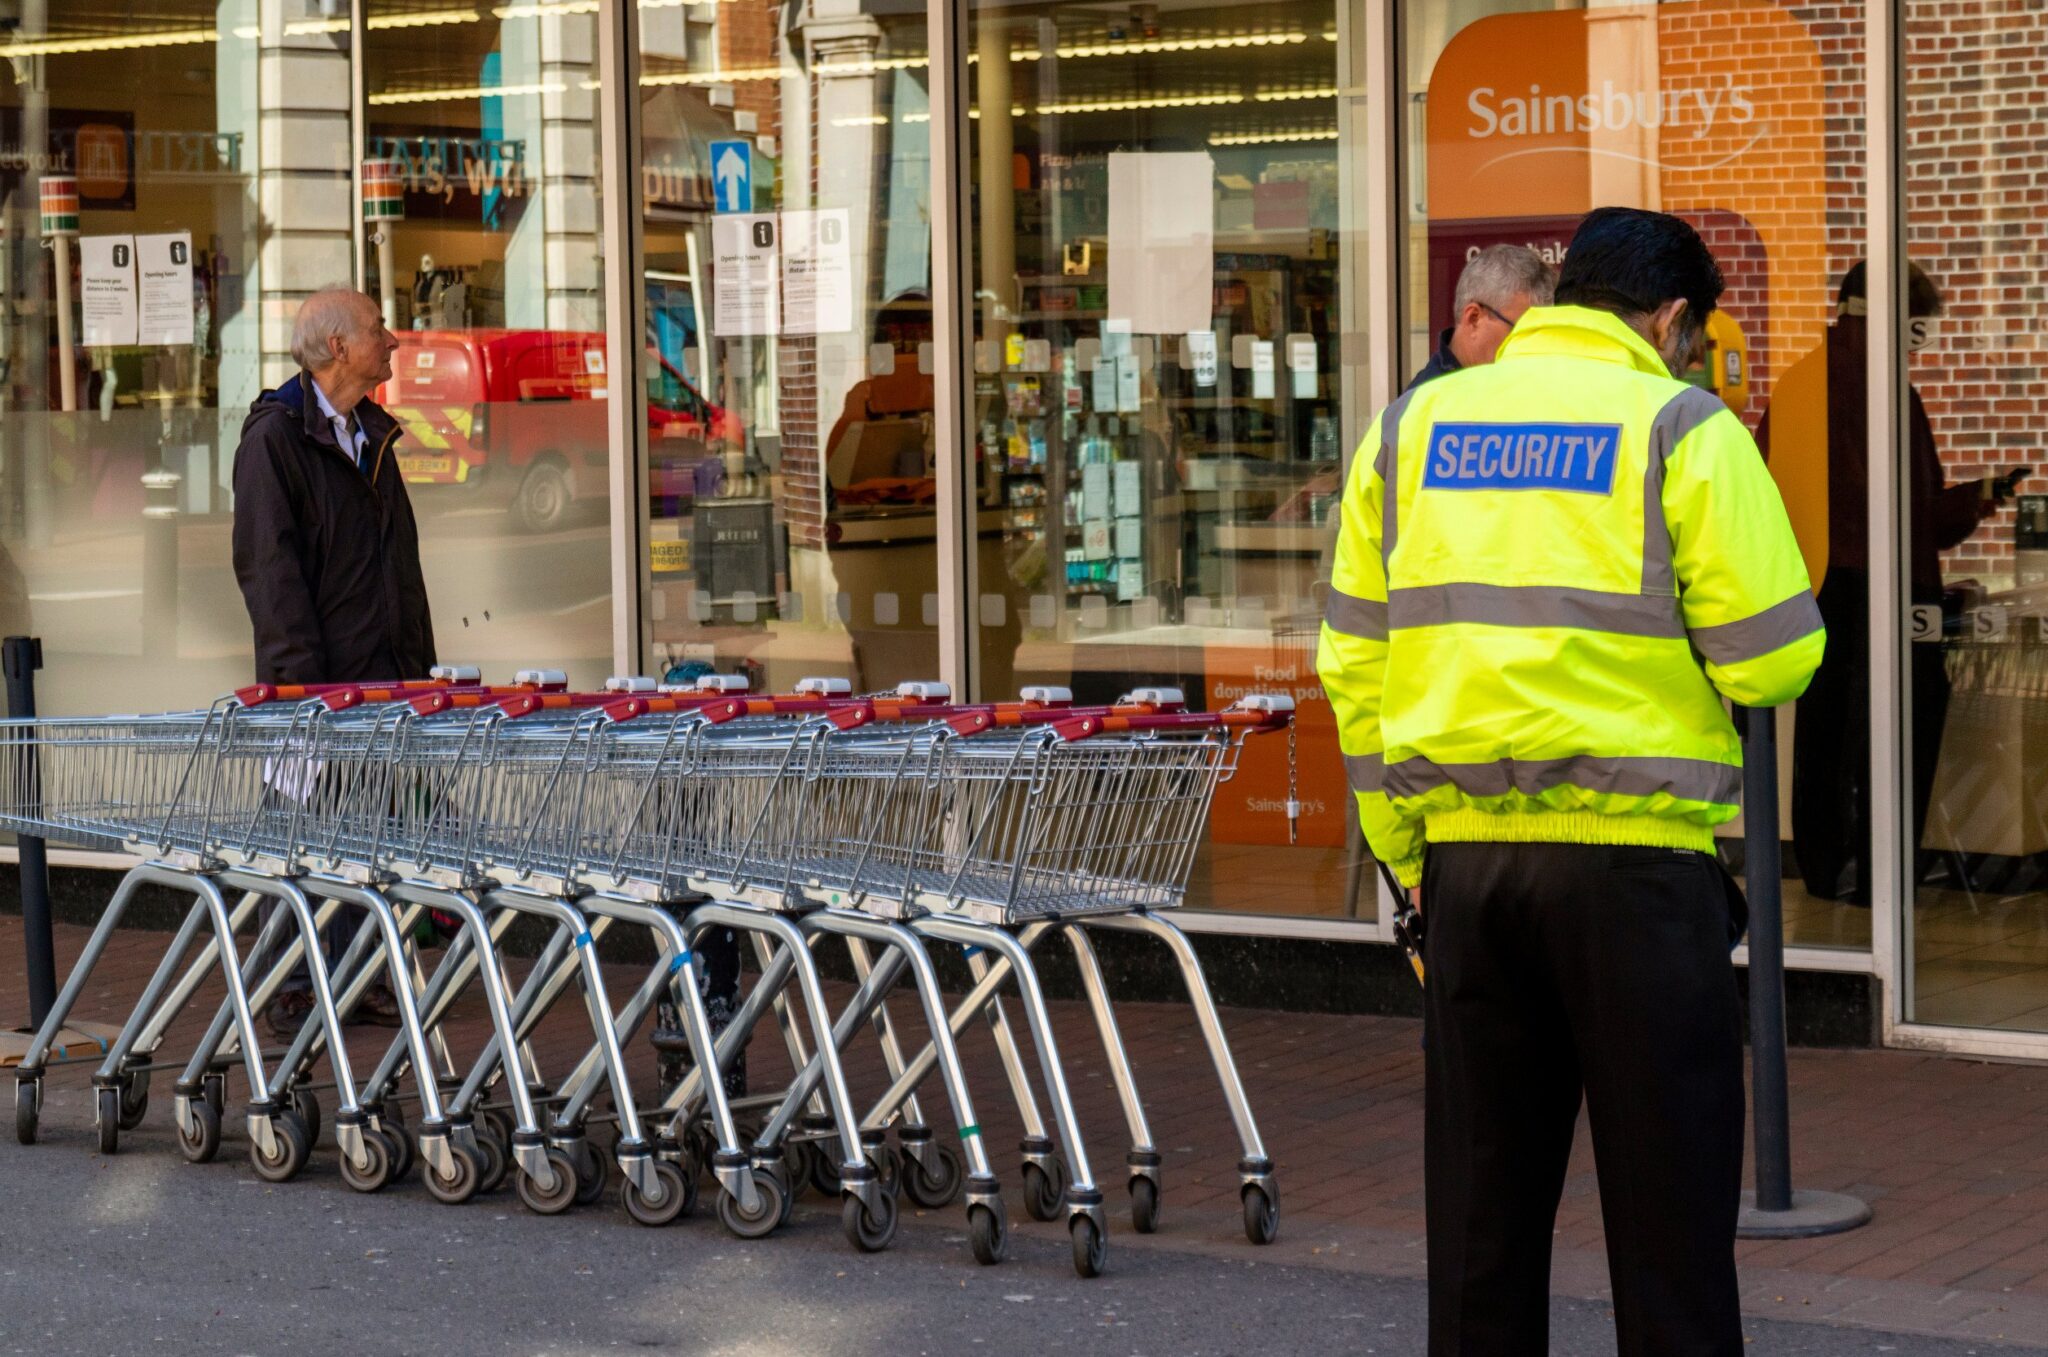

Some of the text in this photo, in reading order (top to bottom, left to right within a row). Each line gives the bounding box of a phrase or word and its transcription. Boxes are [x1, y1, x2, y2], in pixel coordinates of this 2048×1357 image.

[1467, 74, 1755, 139] Sainsbury's
[1434, 433, 1609, 481] SECURITY
[1254, 665, 1297, 681] Food
[1214, 682, 1290, 699] donation
[1247, 798, 1325, 815] Sainsry's
